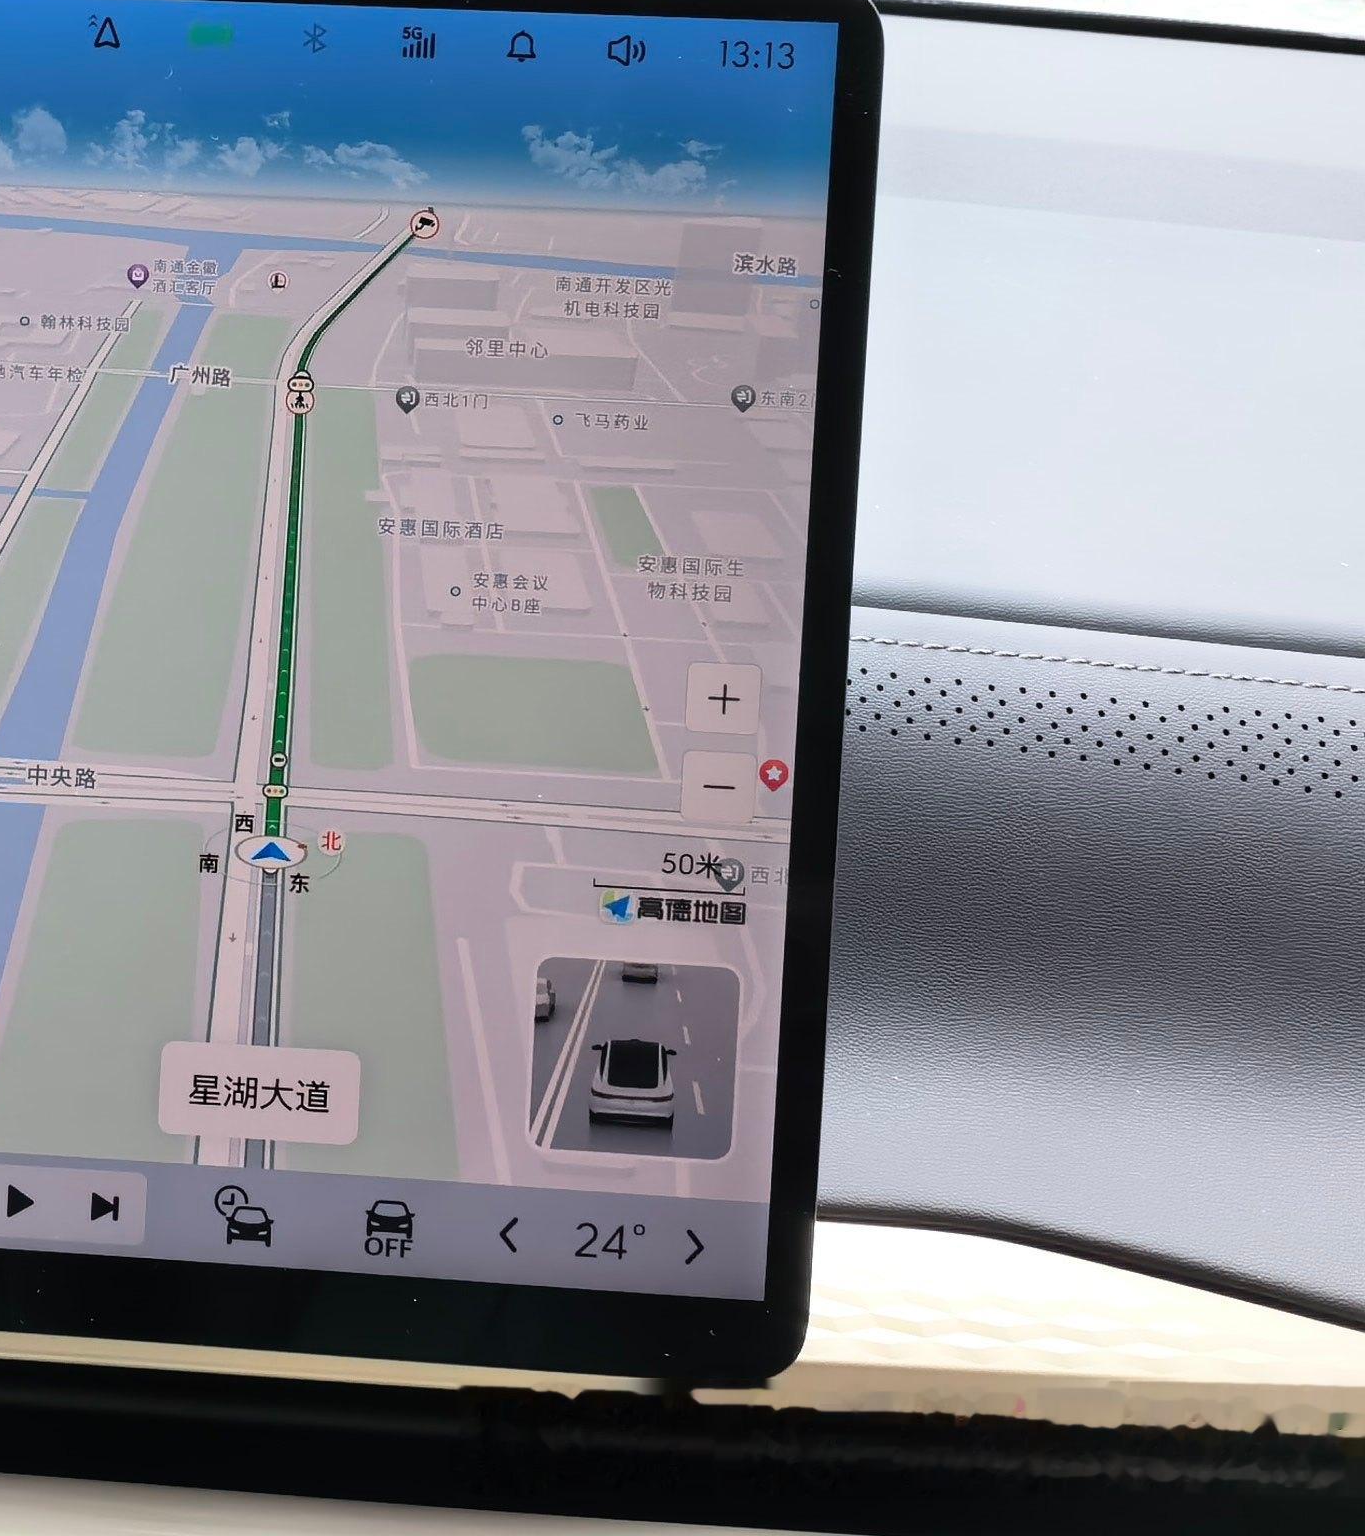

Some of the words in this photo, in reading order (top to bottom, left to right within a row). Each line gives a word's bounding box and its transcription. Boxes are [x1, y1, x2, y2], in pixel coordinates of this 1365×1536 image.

[402, 26, 423, 40] 5G
[720, 40, 794, 69] 13:13
[734, 253, 797, 277] 滨水路
[555, 277, 673, 297] 南通开发区光
[564, 300, 659, 320] 机电科技园
[41, 314, 129, 332] 翰林科技园
[466, 338, 549, 359] 邻里中心
[170, 365, 231, 386] 广州路
[425, 393, 488, 409] 西北1门
[760, 390, 813, 408] 东南2
[576, 413, 649, 431] 飞马药业
[378, 517, 504, 540] 安惠国际酒店
[638, 556, 744, 577] 安惠国际生
[473, 572, 548, 591] 安惠会议
[648, 583, 732, 603] 物科技园
[472, 597, 541, 615] 中心B座
[27, 766, 97, 790] 中央路
[235, 814, 254, 833] 西
[321, 831, 341, 851] 北
[199, 853, 219, 873] 南
[662, 852, 722, 879] 50米
[289, 873, 310, 893] 东
[638, 896, 746, 925] 高德地图
[189, 1074, 330, 1113] 星湖大道
[364, 1237, 413, 1258] OFF
